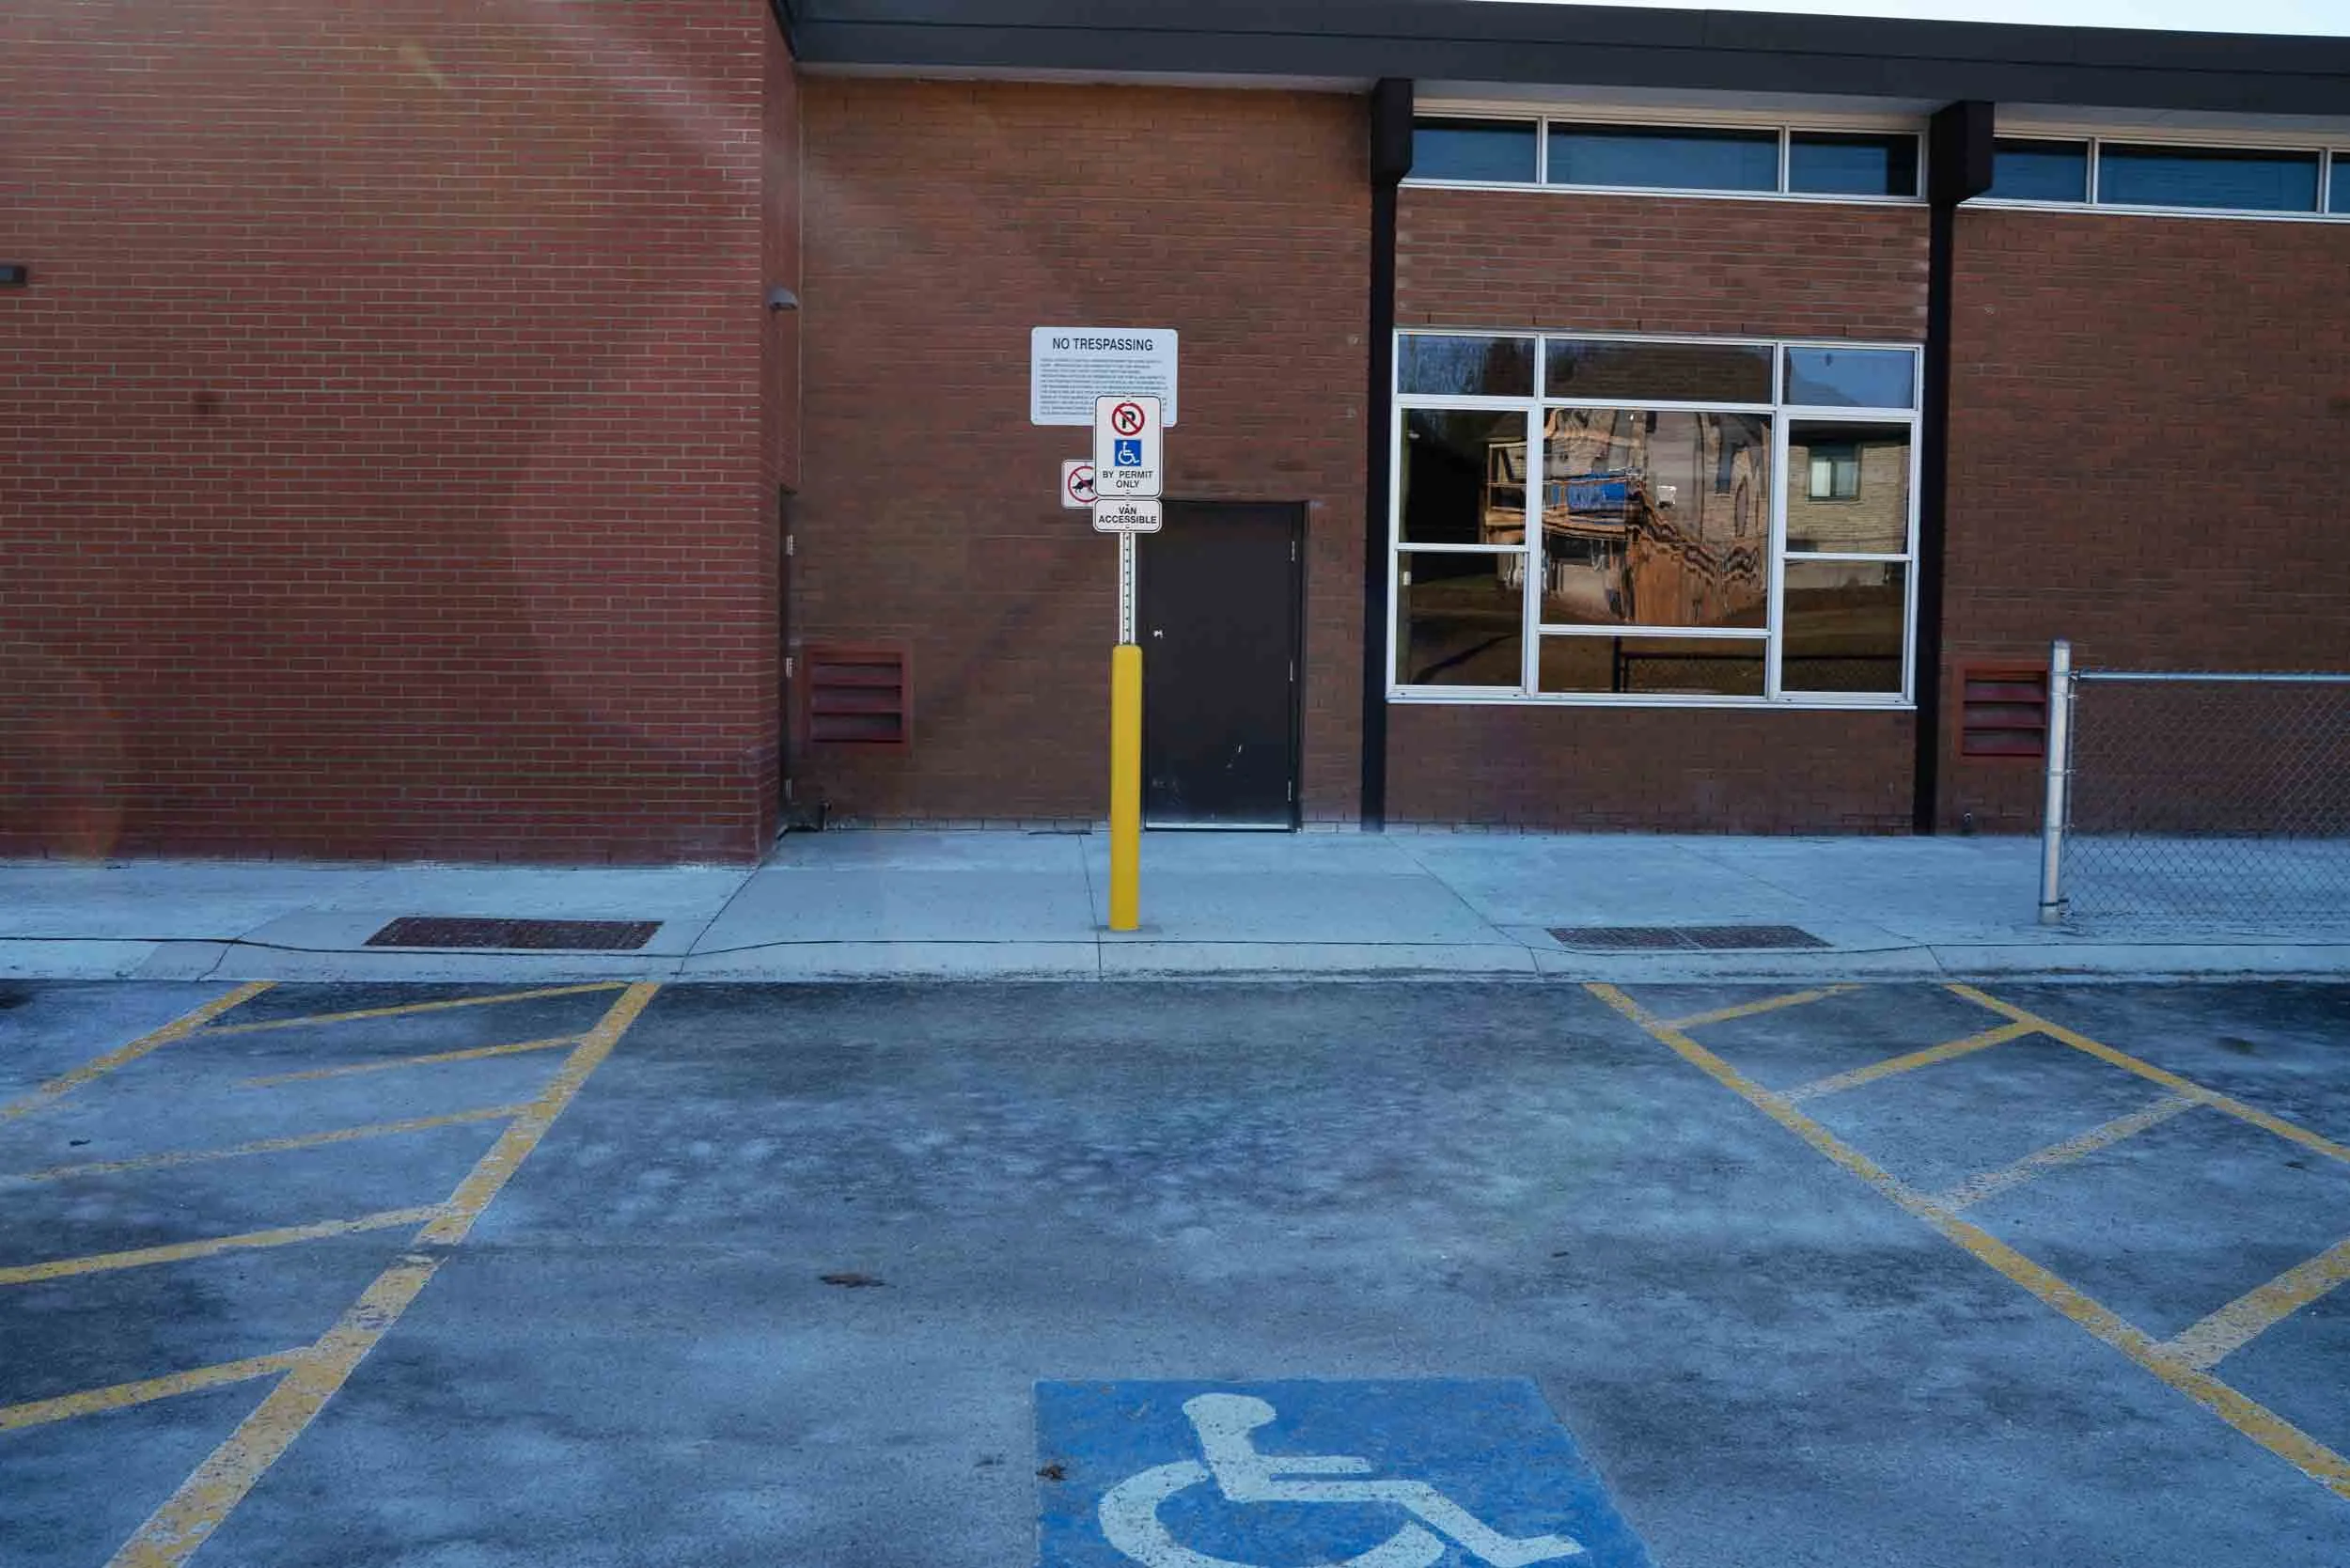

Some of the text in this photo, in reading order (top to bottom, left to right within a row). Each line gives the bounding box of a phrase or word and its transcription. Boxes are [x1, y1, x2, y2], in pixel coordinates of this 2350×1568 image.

[1052, 337, 1154, 352] NO TRESPASSING
[1121, 411, 1136, 429] P
[1103, 470, 1153, 478] BY PERMIT
[1116, 479, 1139, 489] ONLY
[1119, 507, 1136, 515] VAN
[1098, 515, 1157, 525] ACCESSIBLE
